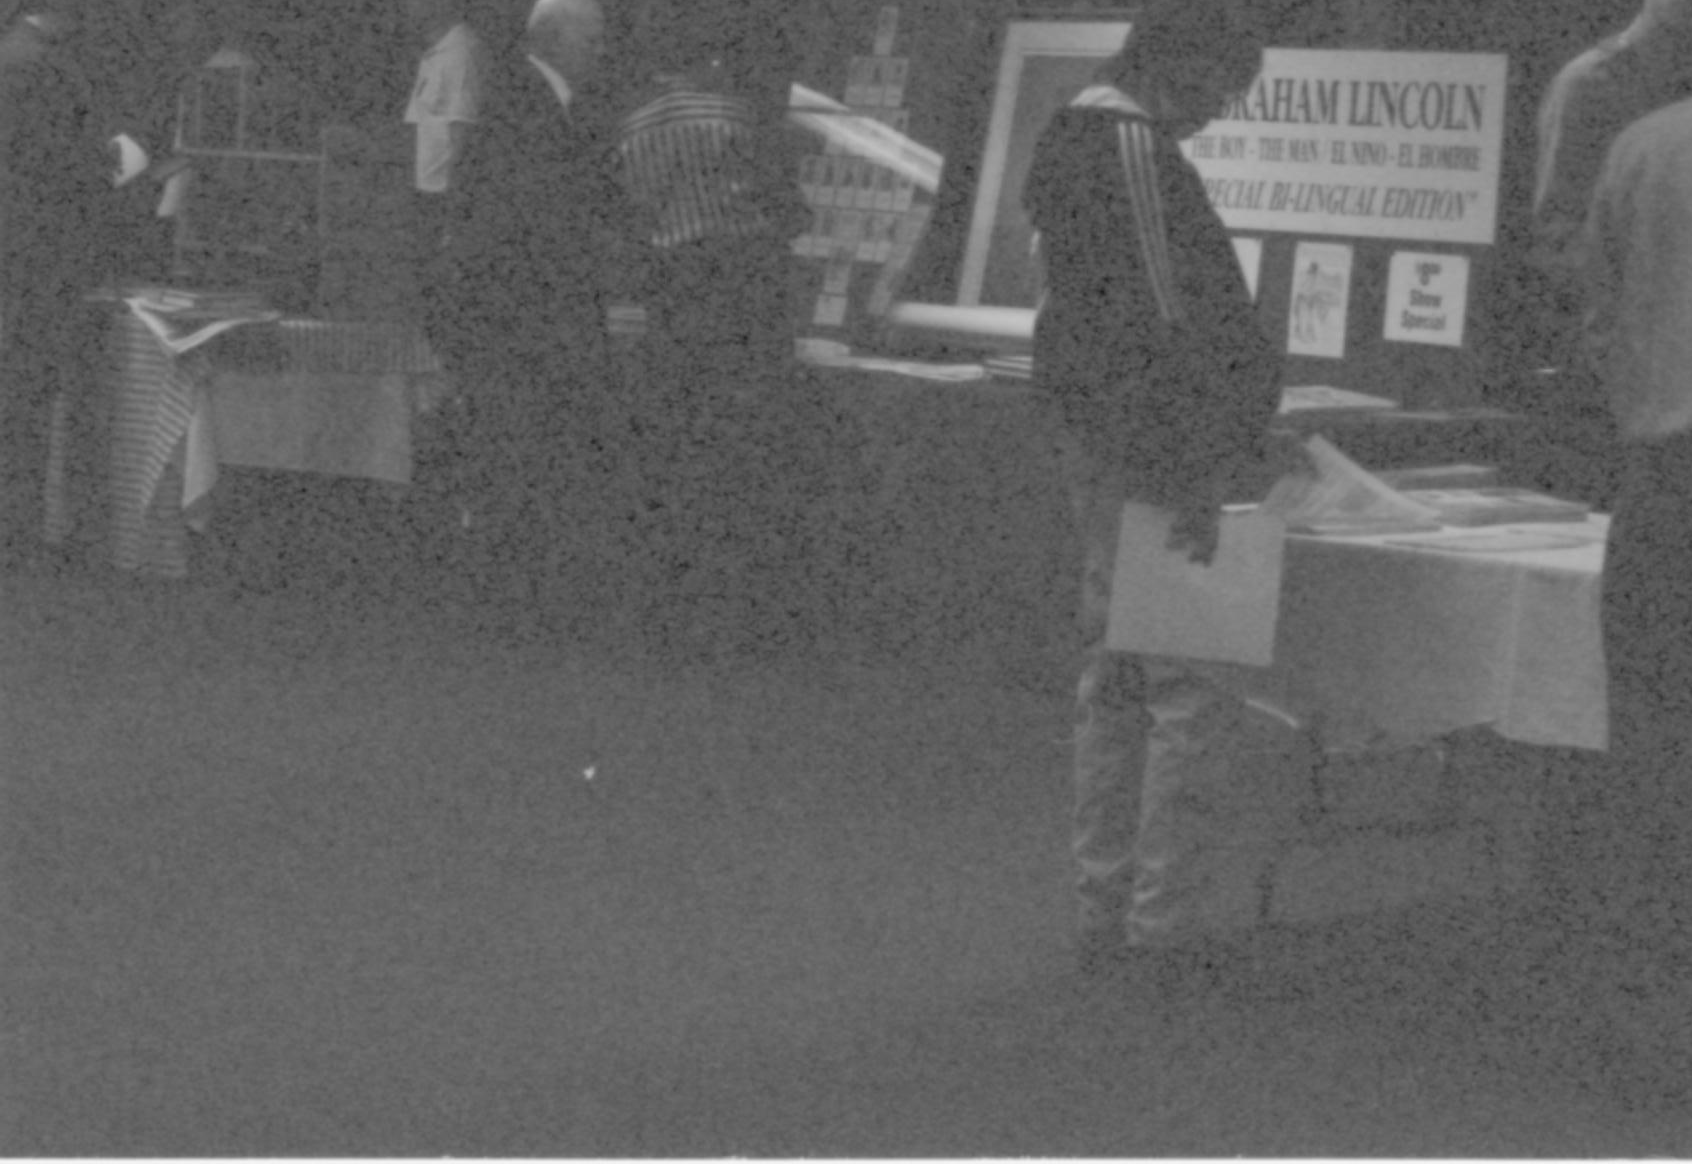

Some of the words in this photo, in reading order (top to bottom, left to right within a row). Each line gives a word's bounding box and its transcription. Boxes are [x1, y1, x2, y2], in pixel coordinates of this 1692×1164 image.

[1347, 79, 1486, 132] LINCOLN
[1192, 135, 1216, 159] THE
[1219, 136, 1246, 160] BOY
[1258, 137, 1285, 162] THE
[1289, 138, 1319, 163] MAN
[1330, 140, 1347, 165] EL
[1397, 143, 1415, 168] EL
[1418, 144, 1482, 171] HOMBRE
[1268, 180, 1379, 217] BI-LINGUAL
